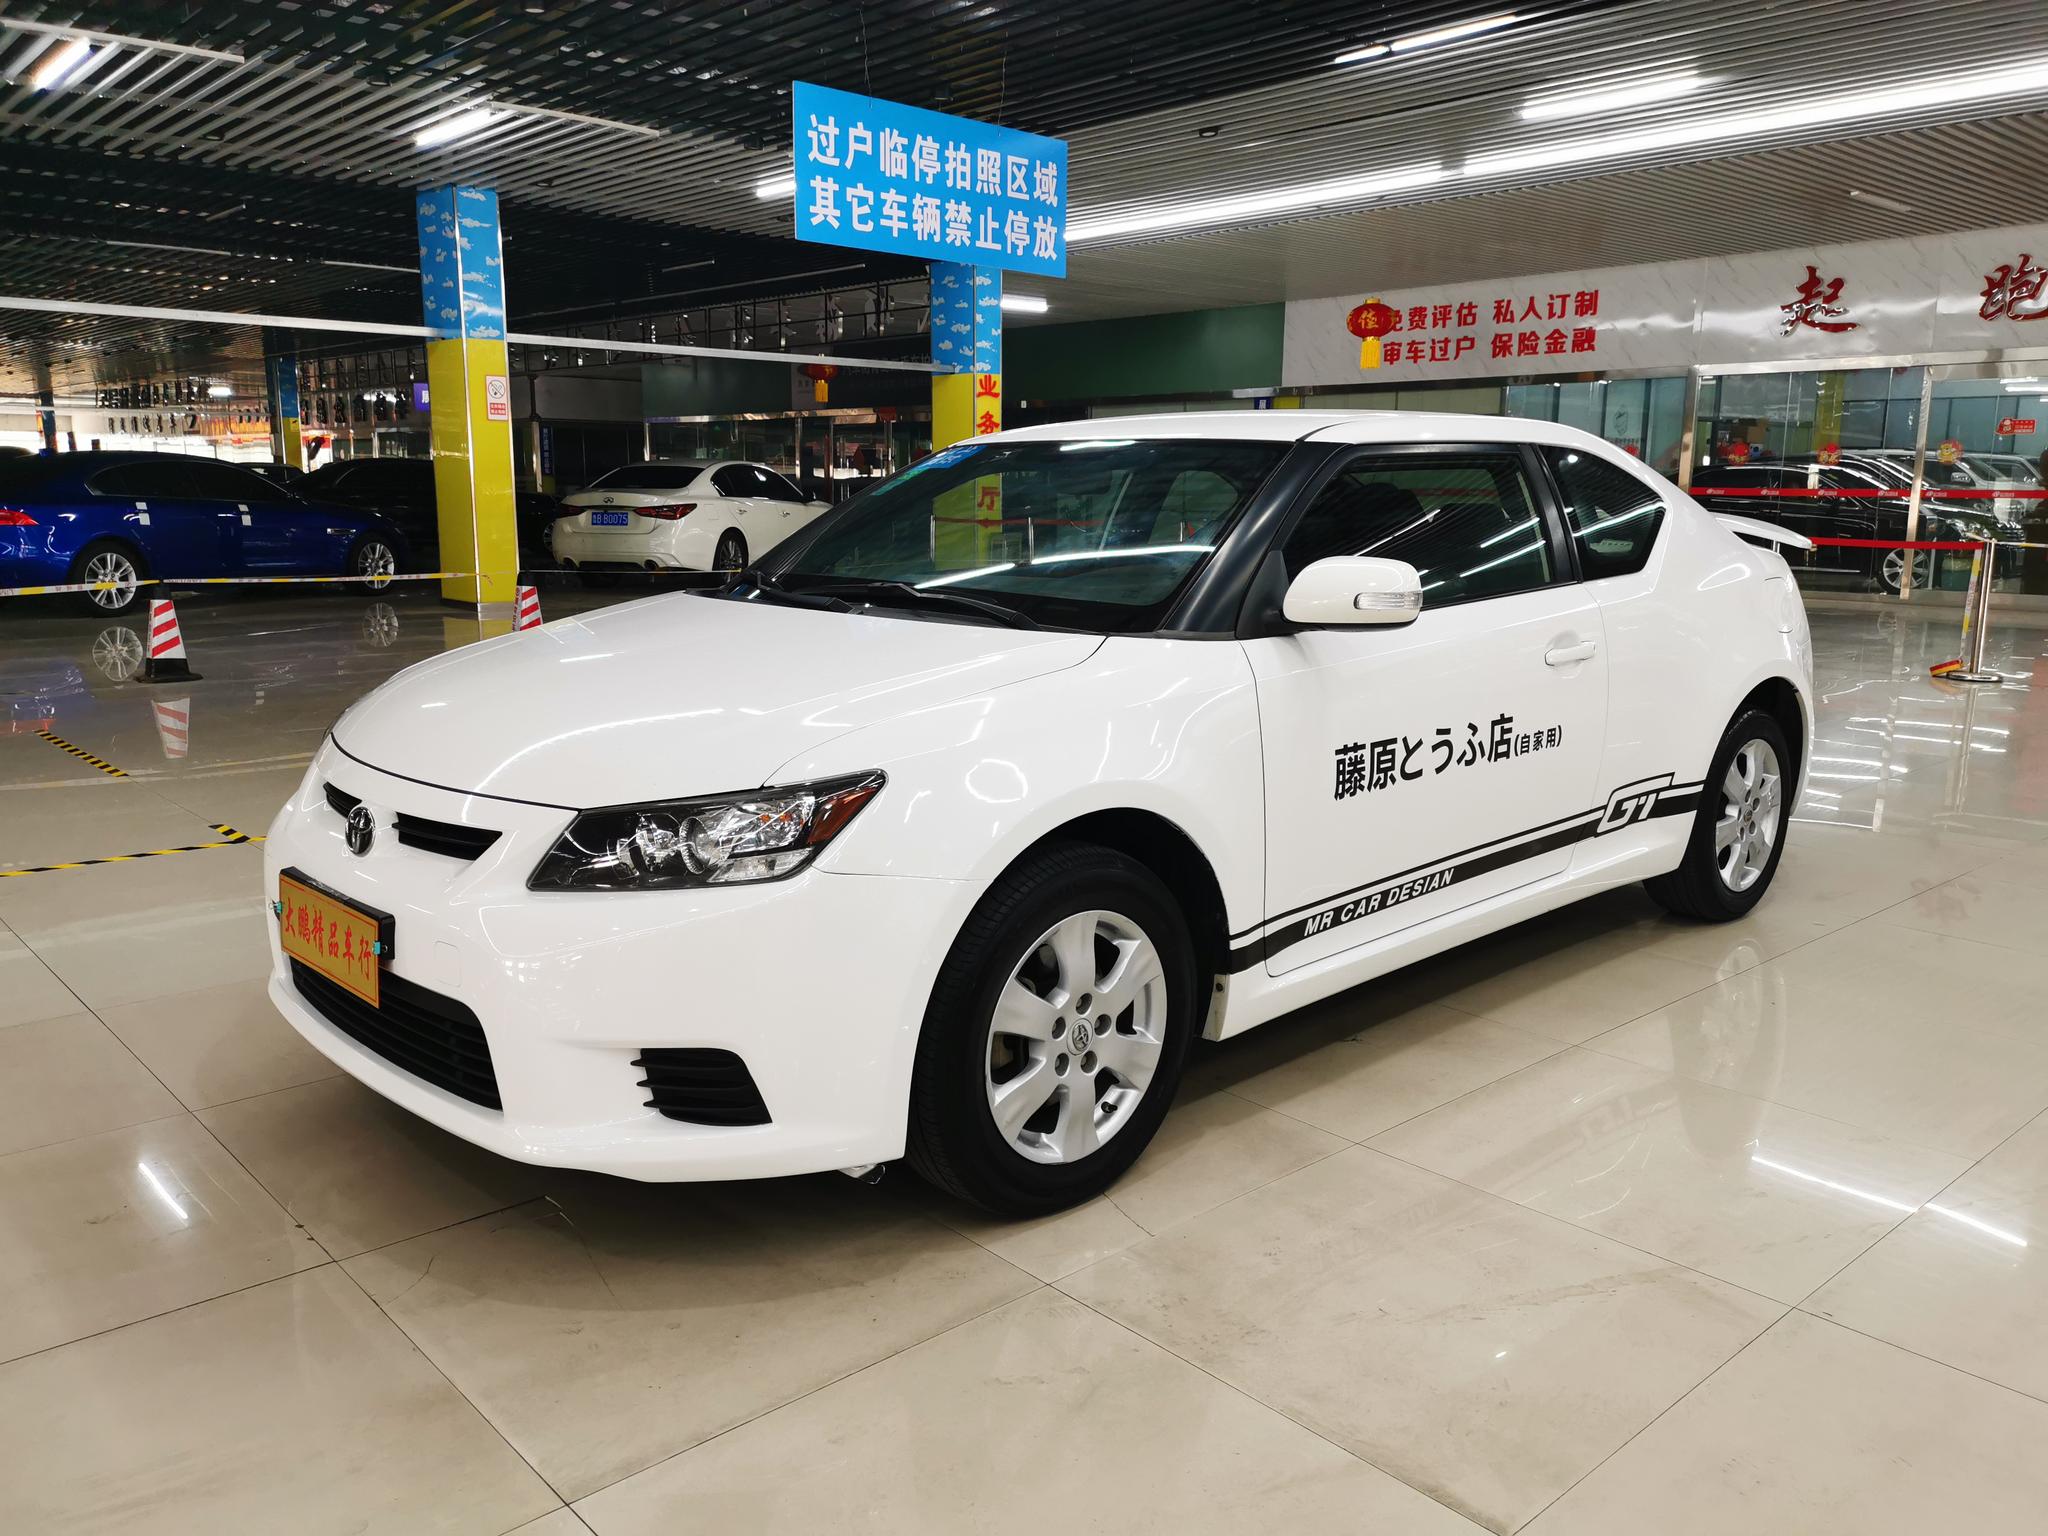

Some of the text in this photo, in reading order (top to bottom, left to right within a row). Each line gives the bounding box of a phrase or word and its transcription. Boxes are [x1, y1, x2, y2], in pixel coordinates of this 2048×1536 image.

[807, 113, 1059, 208] 过户临停拍照区域
[809, 175, 1058, 261] 其它车辆禁止停放
[1493, 289, 1599, 324] 私人订制
[1383, 326, 1597, 366] 审车过户 保险金融
[1304, 868, 1455, 937] MR CAR DESIAN
